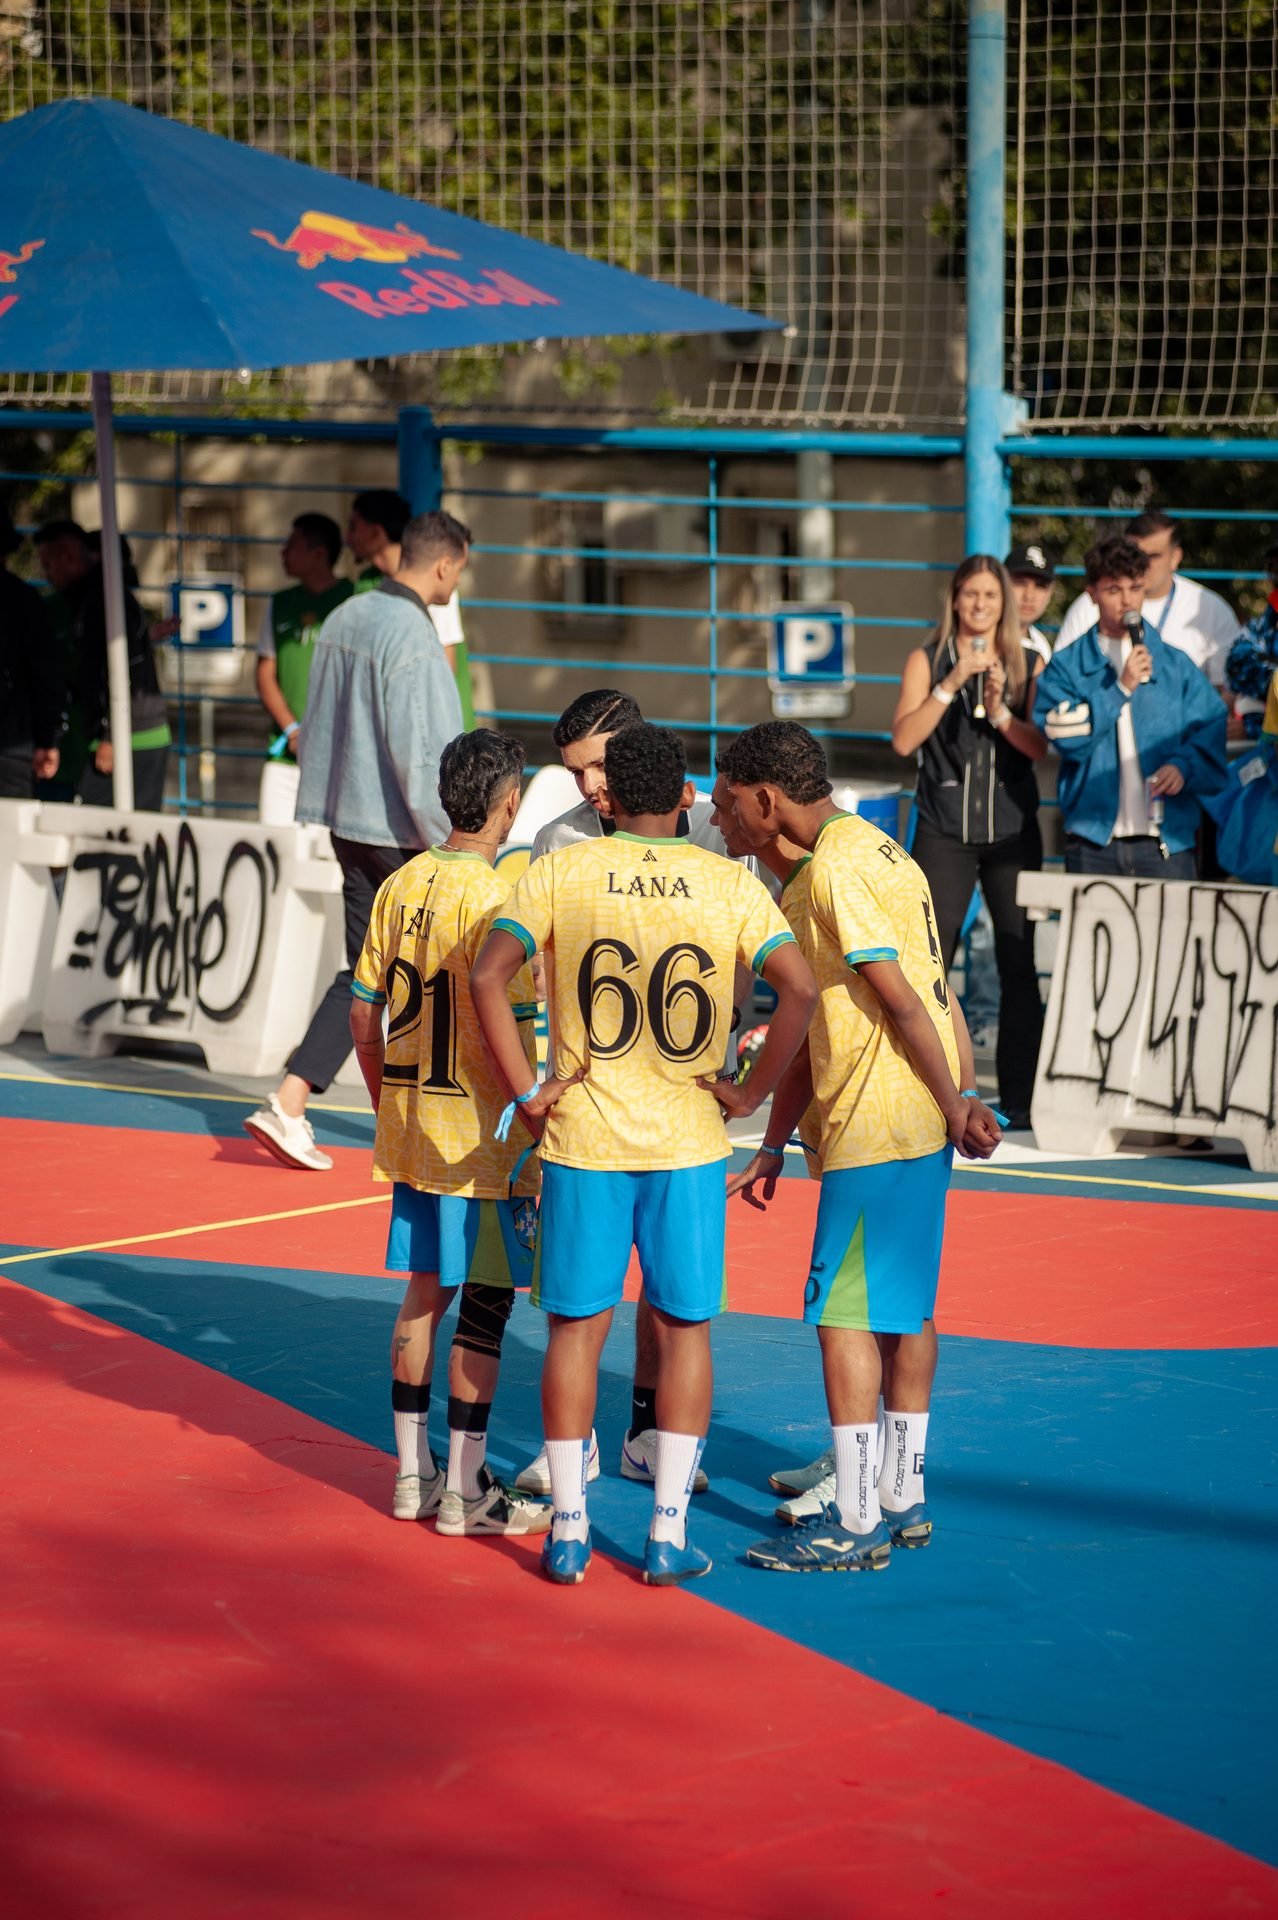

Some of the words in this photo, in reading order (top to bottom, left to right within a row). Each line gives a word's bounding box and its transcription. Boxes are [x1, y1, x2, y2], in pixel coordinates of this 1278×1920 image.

[180, 589, 228, 644] P
[784, 618, 835, 675] P
[607, 872, 693, 899] LANA
[382, 956, 470, 1097] 21
[578, 938, 717, 1063] 66
[553, 1510, 581, 1521] PRO
